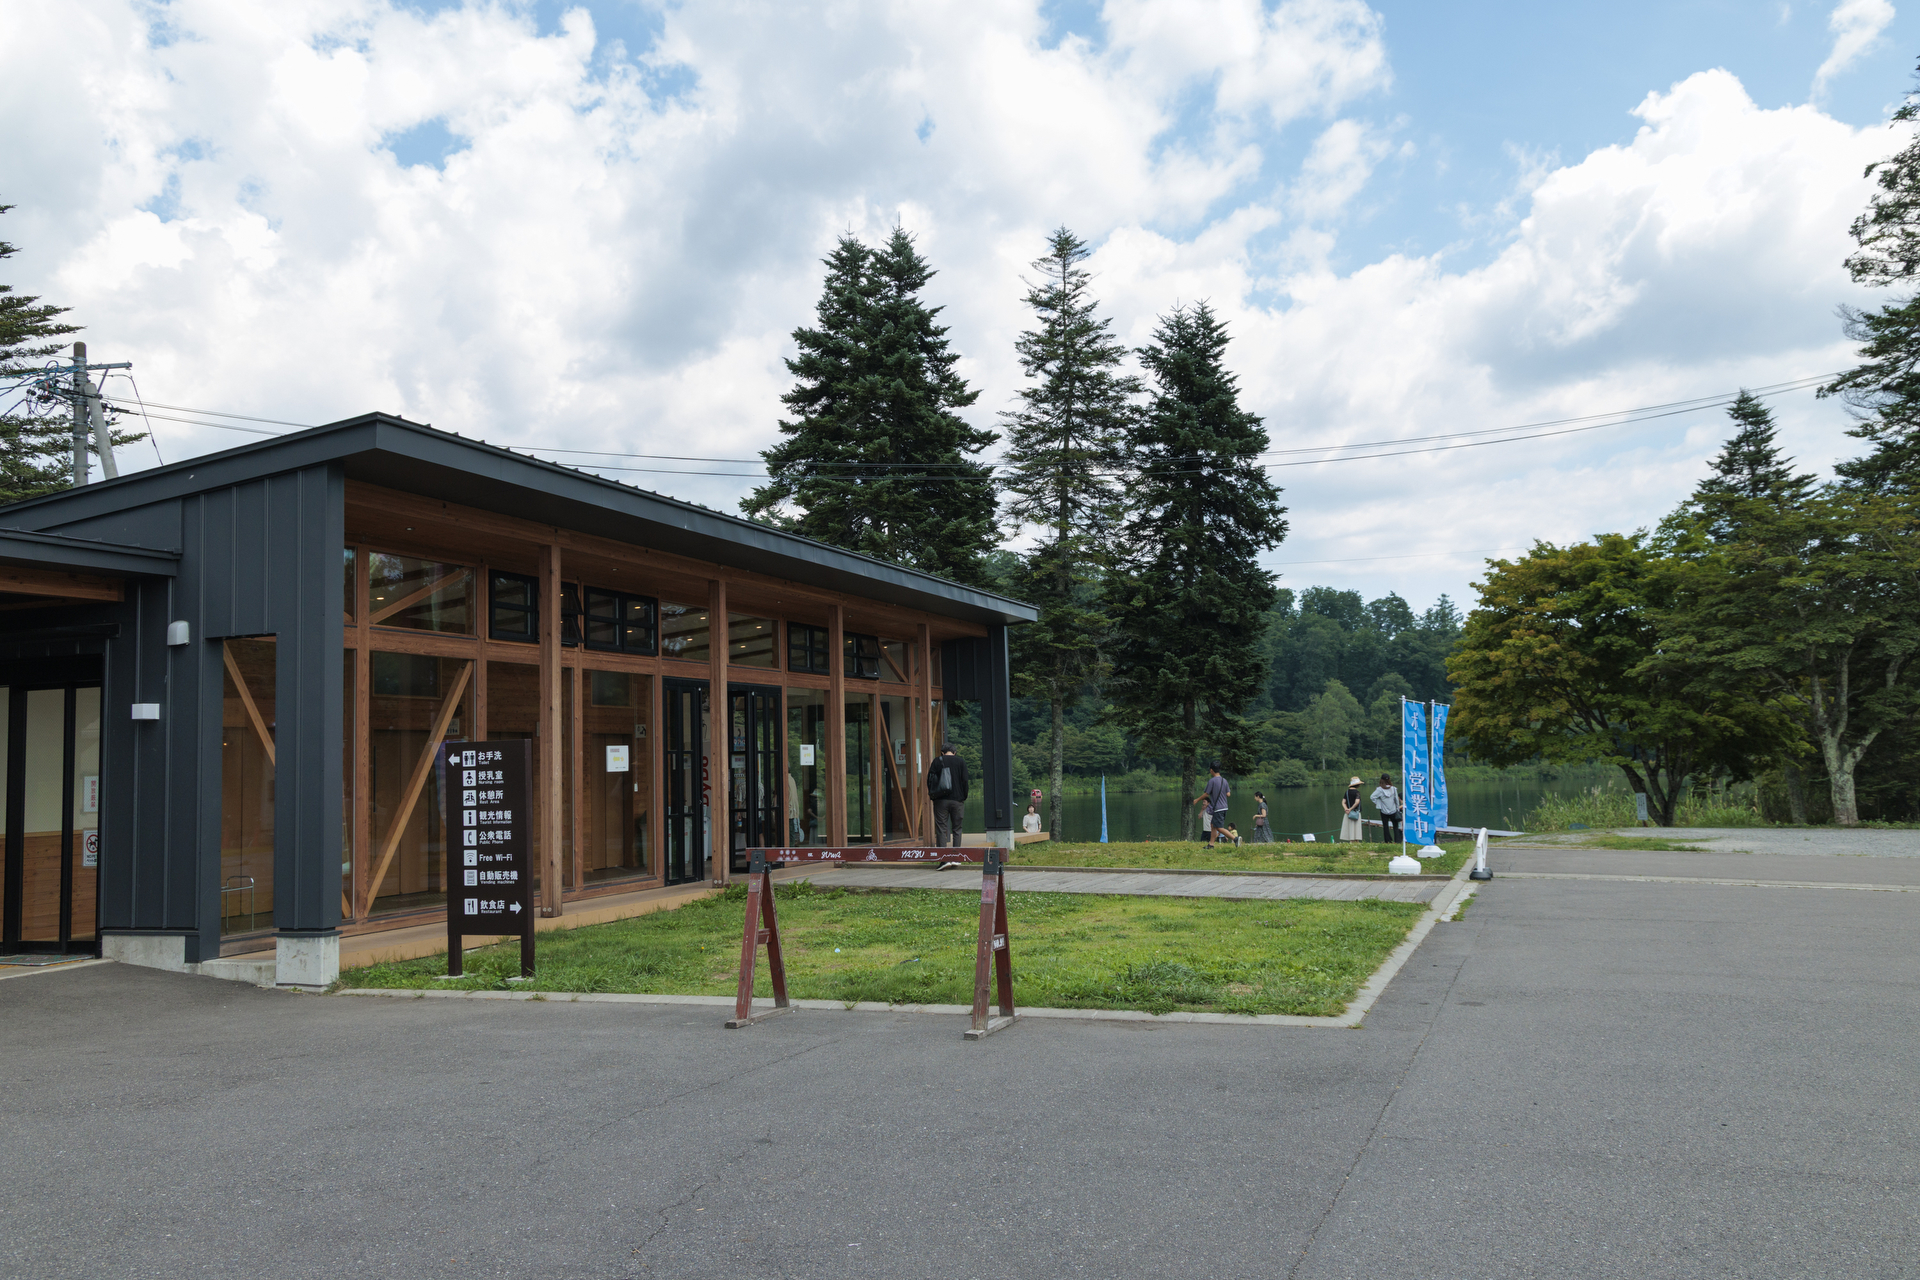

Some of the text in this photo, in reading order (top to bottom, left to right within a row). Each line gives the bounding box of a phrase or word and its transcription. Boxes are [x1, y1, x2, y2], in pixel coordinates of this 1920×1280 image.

[478, 751, 502, 760] お手洗
[478, 771, 503, 780] 授乳室
[1409, 711, 1429, 839] ボート営業中
[479, 790, 503, 800] 休憩所
[479, 810, 512, 820] 観光情報
[479, 830, 512, 840] 公衆電話
[495, 853, 512, 861] Wi-Fi
[480, 870, 518, 881] 自動販売機
[480, 900, 505, 909] 飲食店
